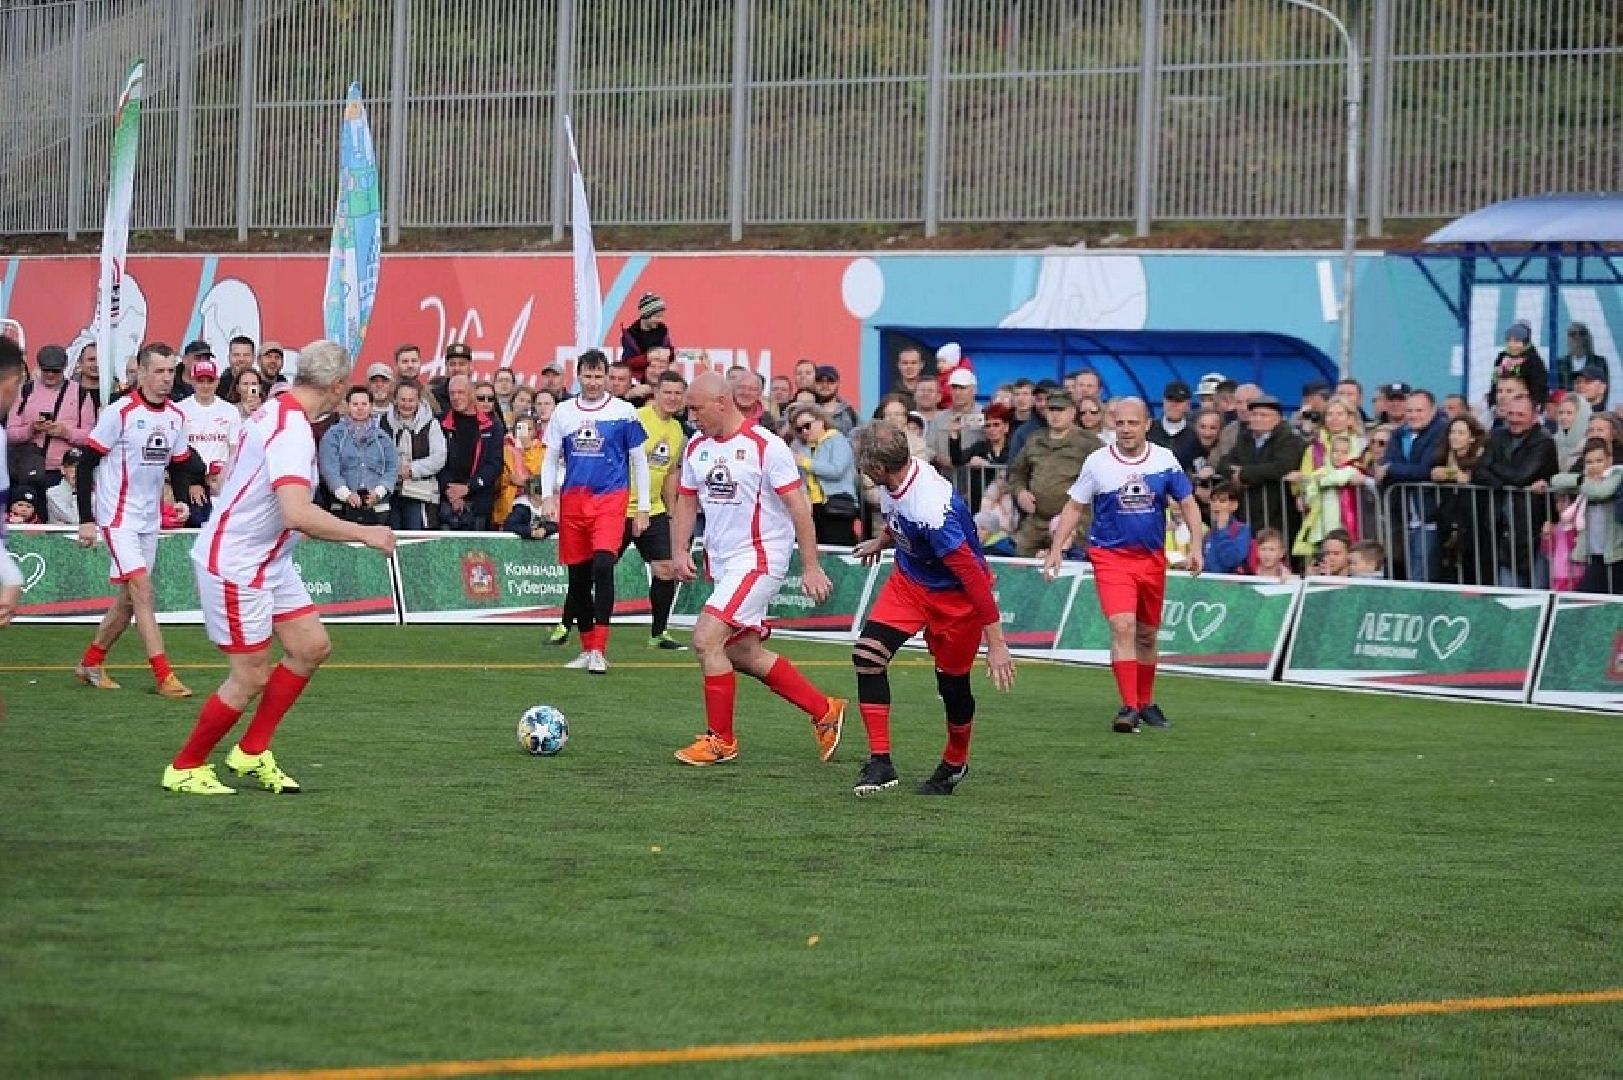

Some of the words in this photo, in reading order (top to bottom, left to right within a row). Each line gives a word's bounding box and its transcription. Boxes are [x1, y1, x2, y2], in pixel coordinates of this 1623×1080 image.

[503, 561, 566, 578] Команда
[507, 579, 569, 596] Губернат
[1356, 612, 1423, 643] ЛЕТО
